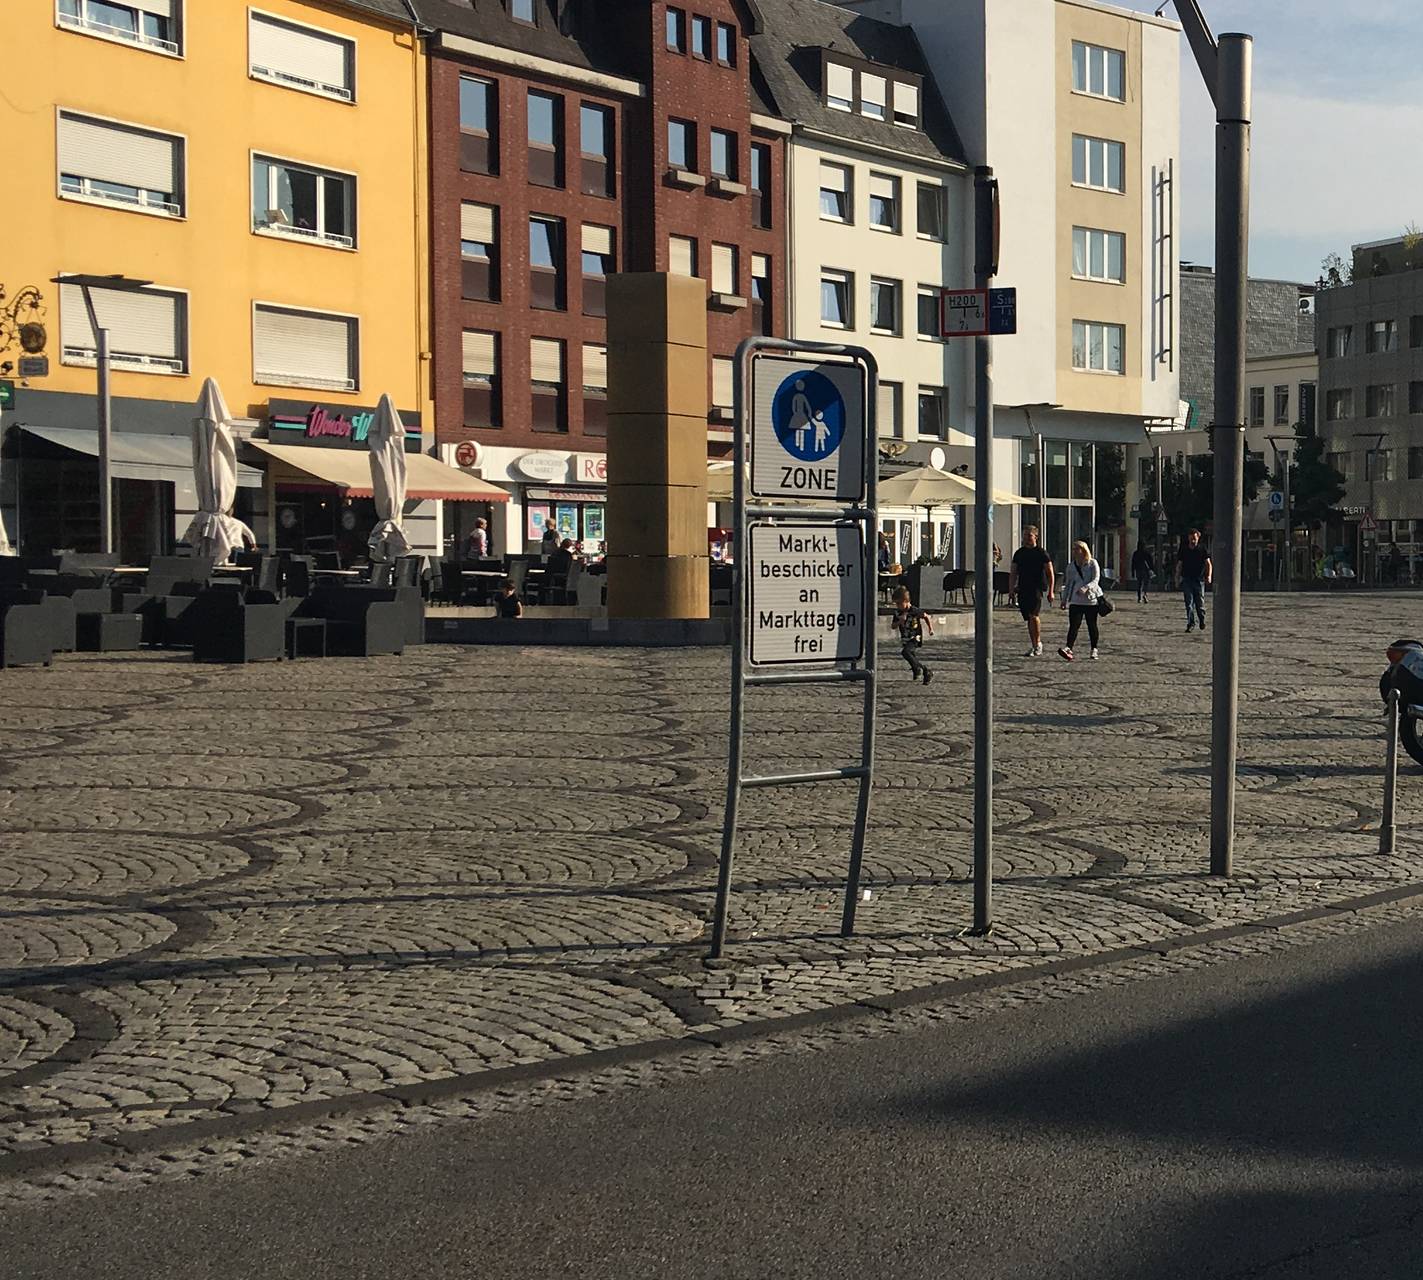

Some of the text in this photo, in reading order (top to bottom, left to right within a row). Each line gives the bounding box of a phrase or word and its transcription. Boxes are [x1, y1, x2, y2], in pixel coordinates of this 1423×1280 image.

[949, 295, 976, 306] H200
[308, 405, 352, 437] Wonder
[779, 466, 837, 491] ZONE
[778, 534, 836, 553] Markt-
[760, 560, 853, 578] beschicker
[798, 588, 819, 603] an
[759, 610, 856, 632] Markttagen
[794, 635, 824, 654] frei
